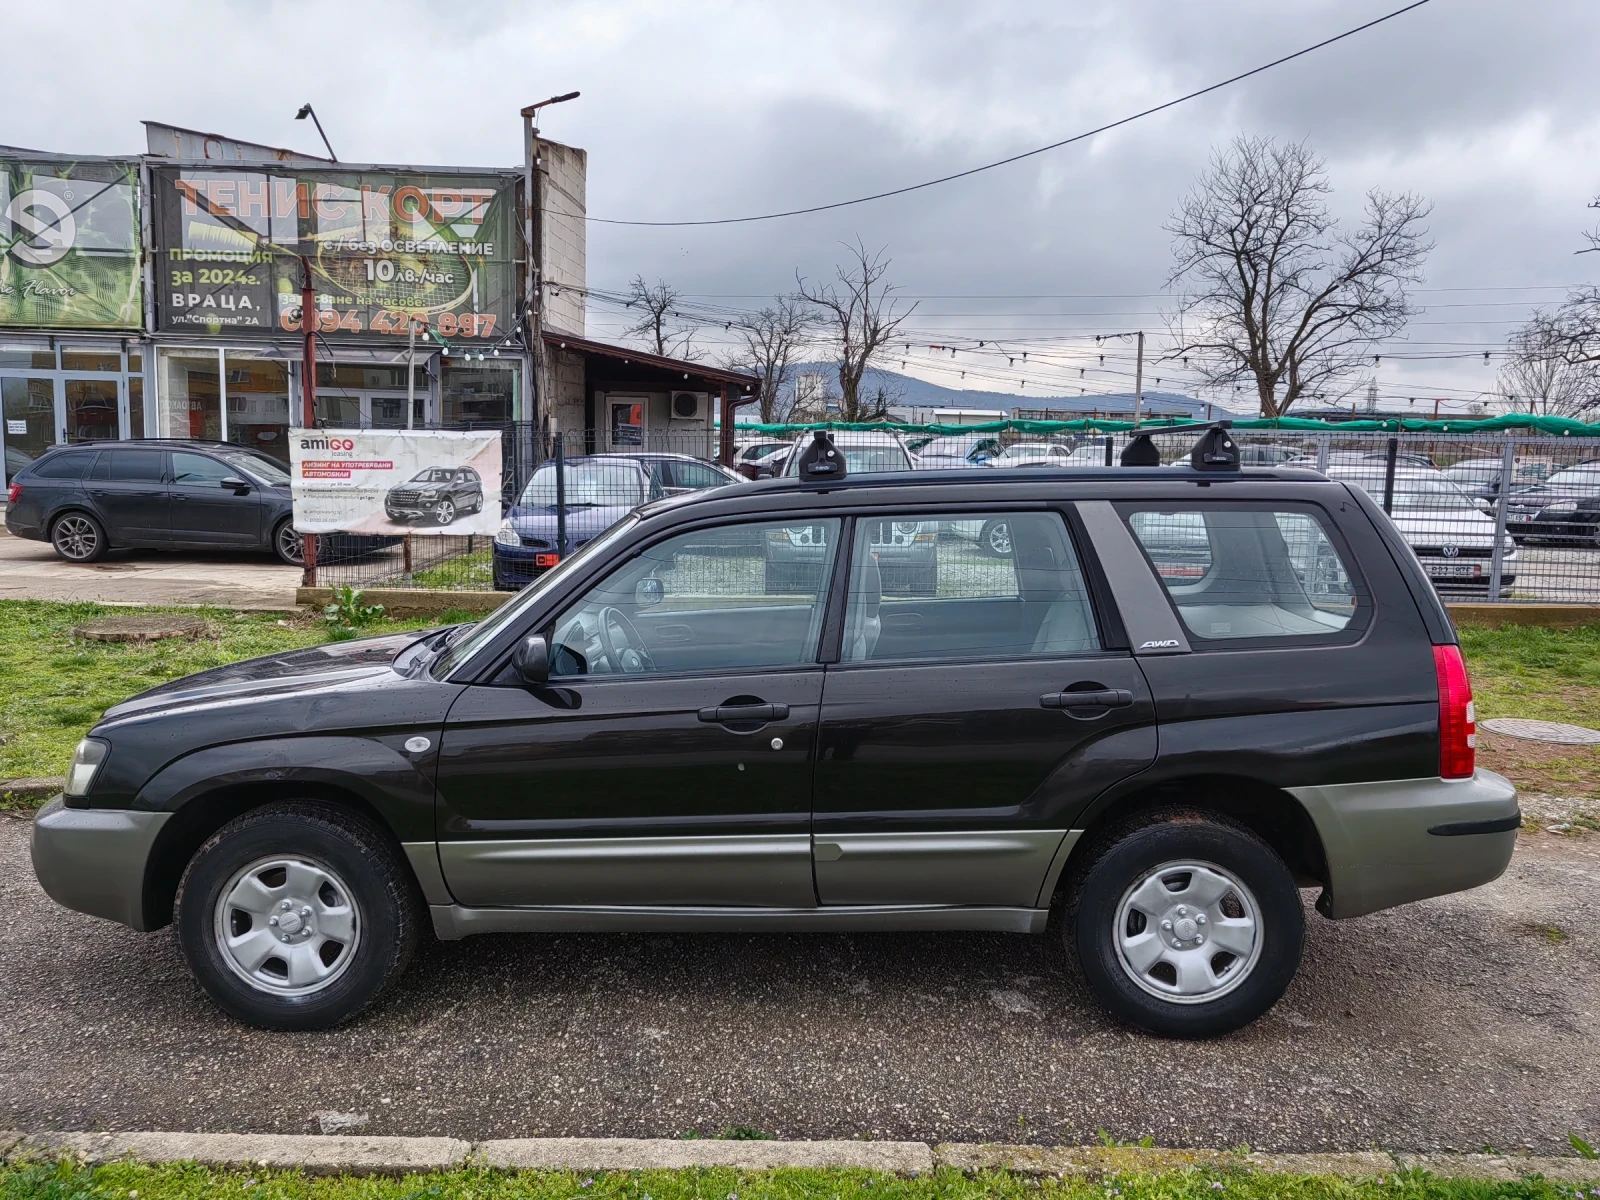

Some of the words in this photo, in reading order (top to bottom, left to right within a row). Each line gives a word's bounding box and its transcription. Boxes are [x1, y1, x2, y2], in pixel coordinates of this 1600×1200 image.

[174, 180, 350, 220] ТЕНИС
[361, 184, 498, 225] КОРТ
[380, 239, 494, 256] ОСВЕТЛЕНИЕ
[169, 248, 273, 265] ПРОМОЦИЯ
[356, 296, 373, 306] на
[370, 309, 430, 335] 420
[437, 312, 497, 338] 887
[331, 450, 353, 458] leasing
[1139, 639, 1180, 650] AWD
